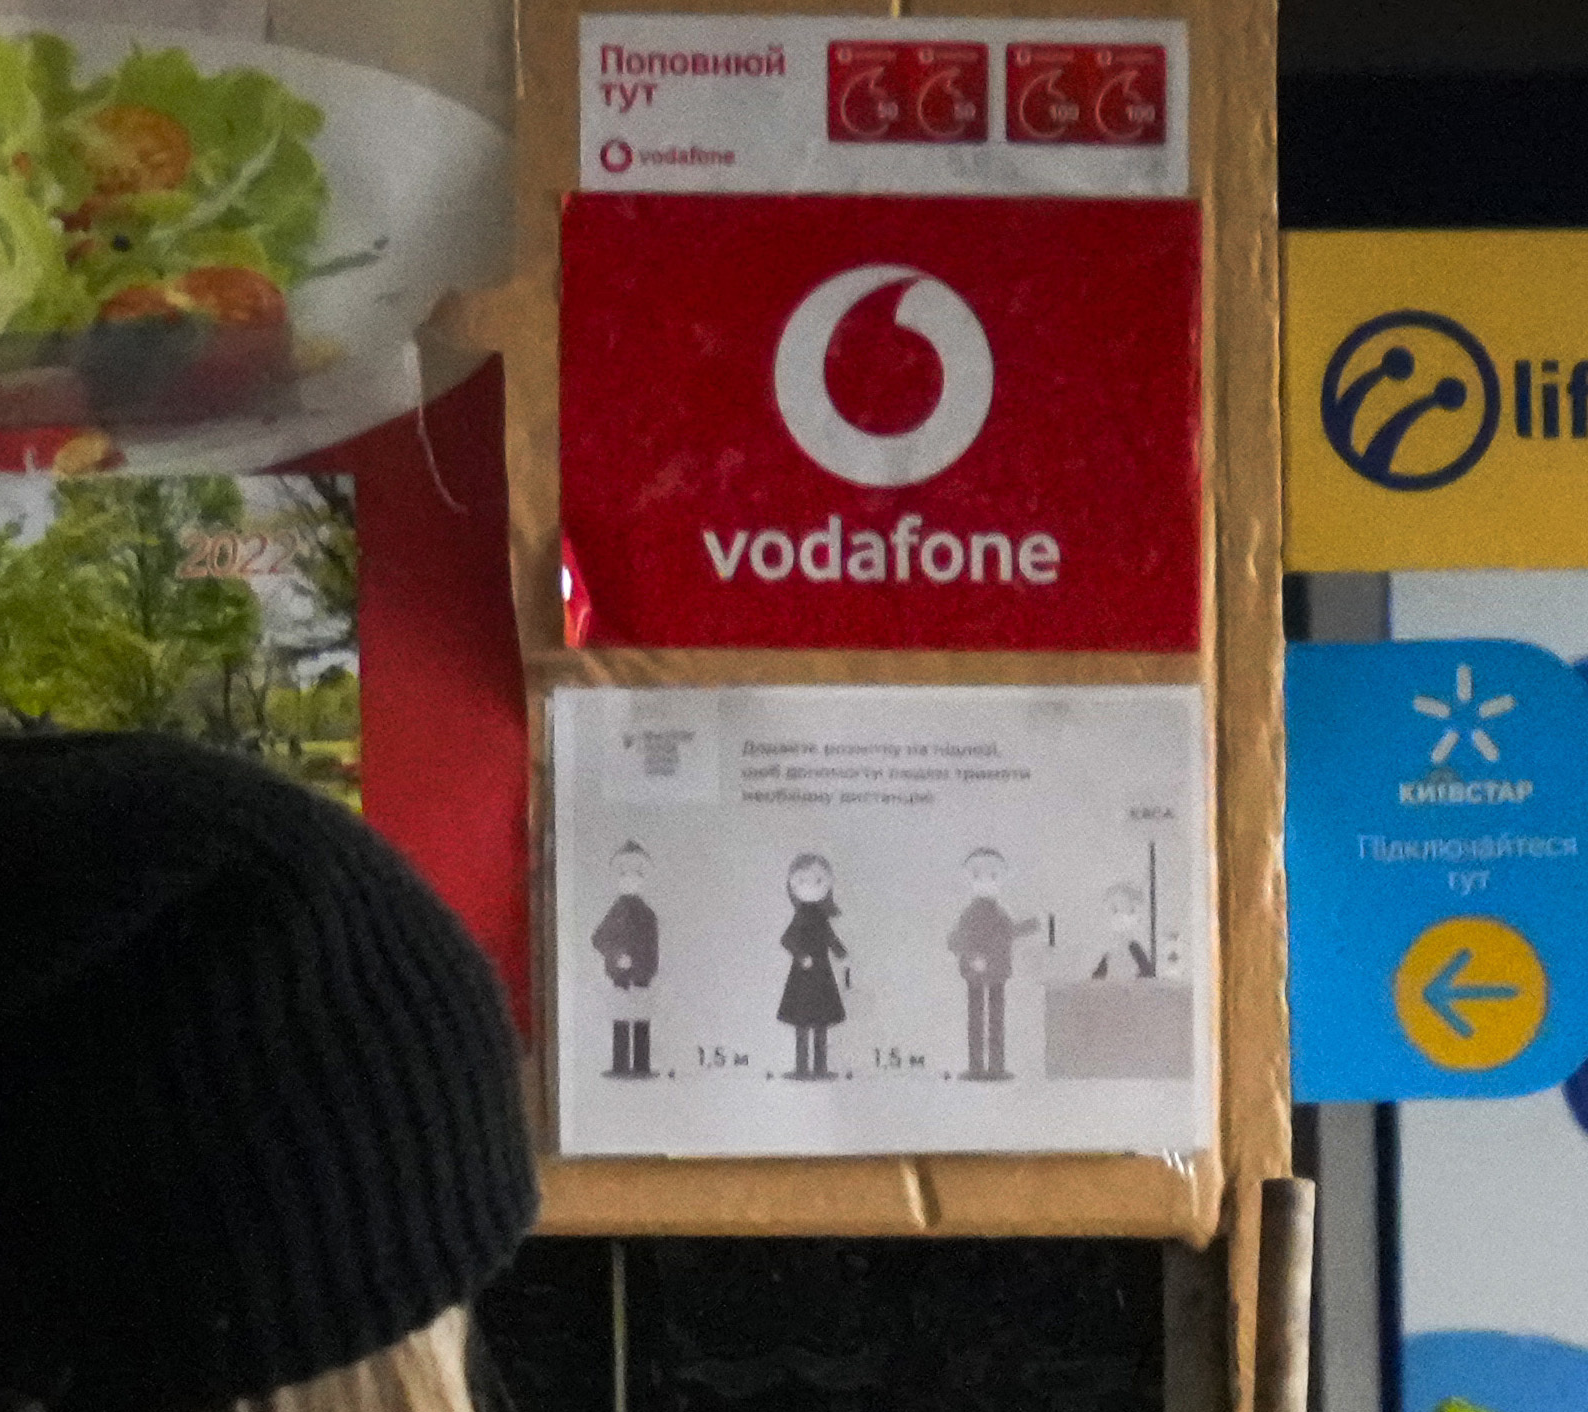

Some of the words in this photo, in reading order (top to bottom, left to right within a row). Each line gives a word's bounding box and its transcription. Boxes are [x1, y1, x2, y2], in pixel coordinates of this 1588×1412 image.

[599, 43, 787, 77] Поповнюй
[600, 80, 658, 112] тут
[638, 145, 736, 167] vodafone
[177, 529, 299, 578] 2022
[703, 514, 1062, 585] vodafone
[1398, 779, 1534, 805] КИЇВСТАР
[1356, 831, 1580, 863] Підключайтеся
[1447, 869, 1491, 896] тут
